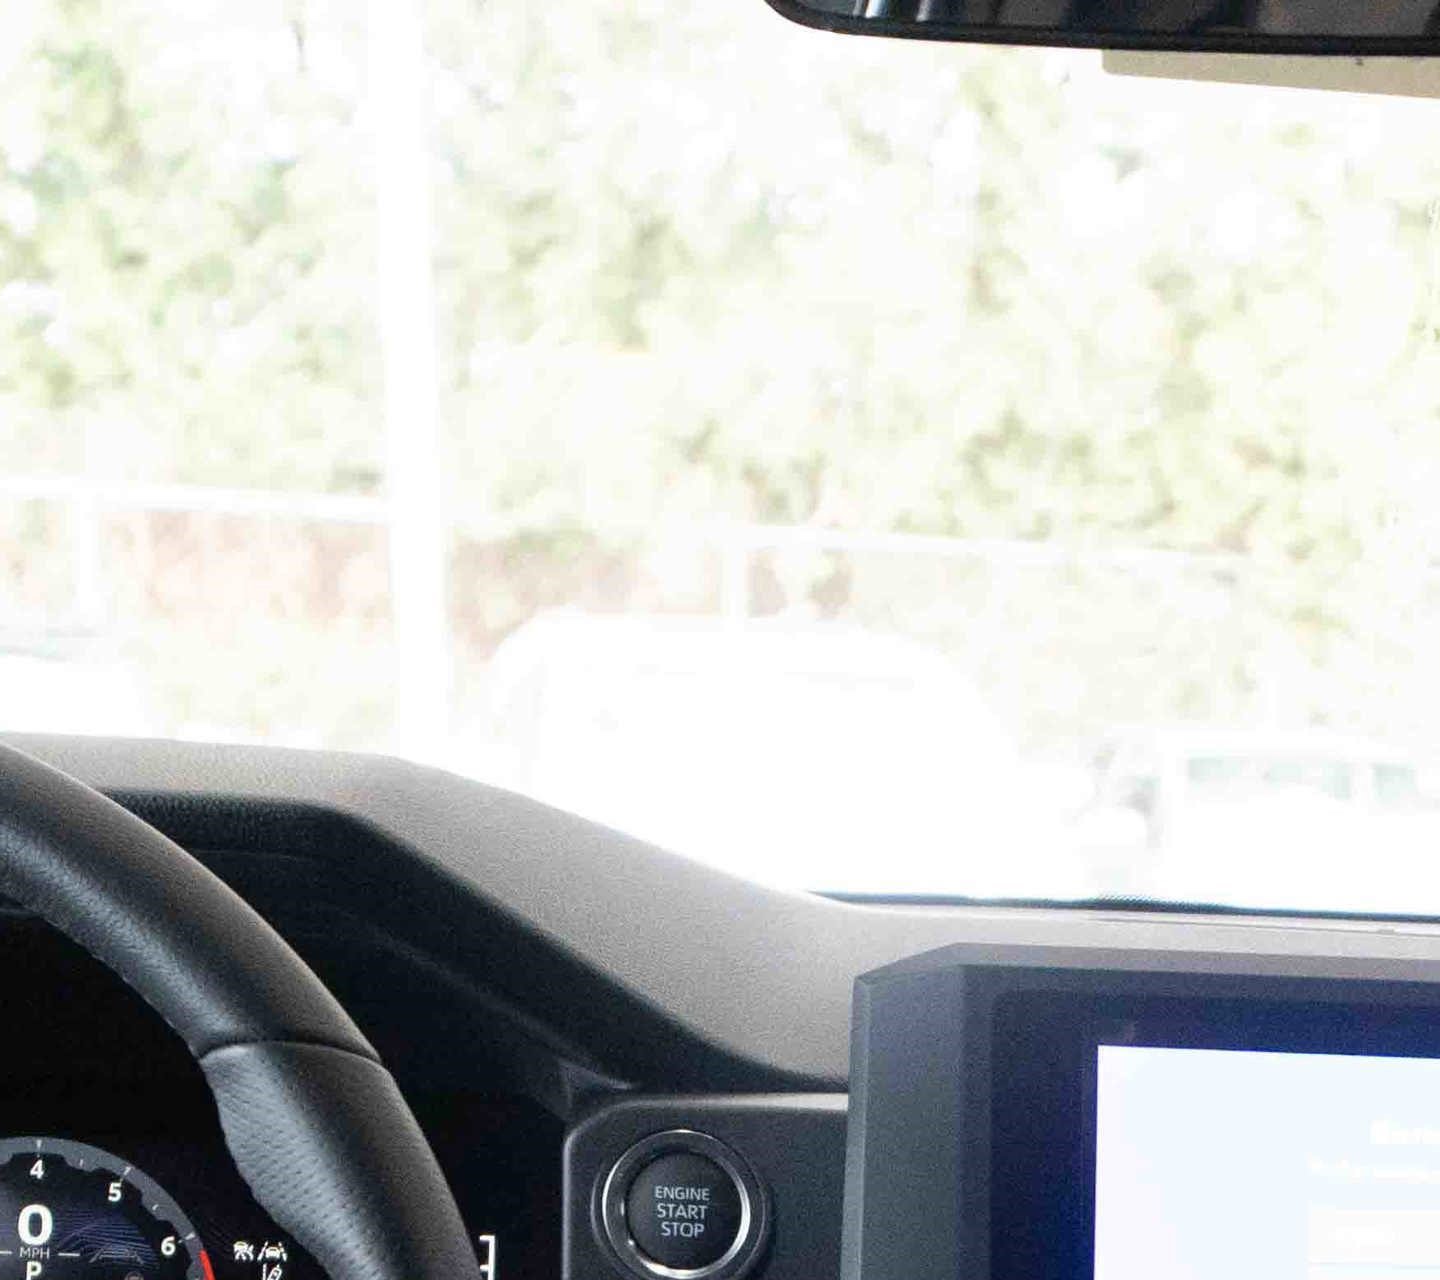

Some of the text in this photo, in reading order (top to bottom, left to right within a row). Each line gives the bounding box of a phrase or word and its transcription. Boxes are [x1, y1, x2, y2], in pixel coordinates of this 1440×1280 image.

[30, 1159, 45, 1179] 4
[108, 1183, 123, 1202] 5
[654, 1185, 711, 1201] ENGINE
[656, 1203, 709, 1219] START
[17, 1203, 54, 1246] 0
[660, 1221, 705, 1238] STOP
[19, 1247, 51, 1260] MPH
[161, 1235, 176, 1256] 6
